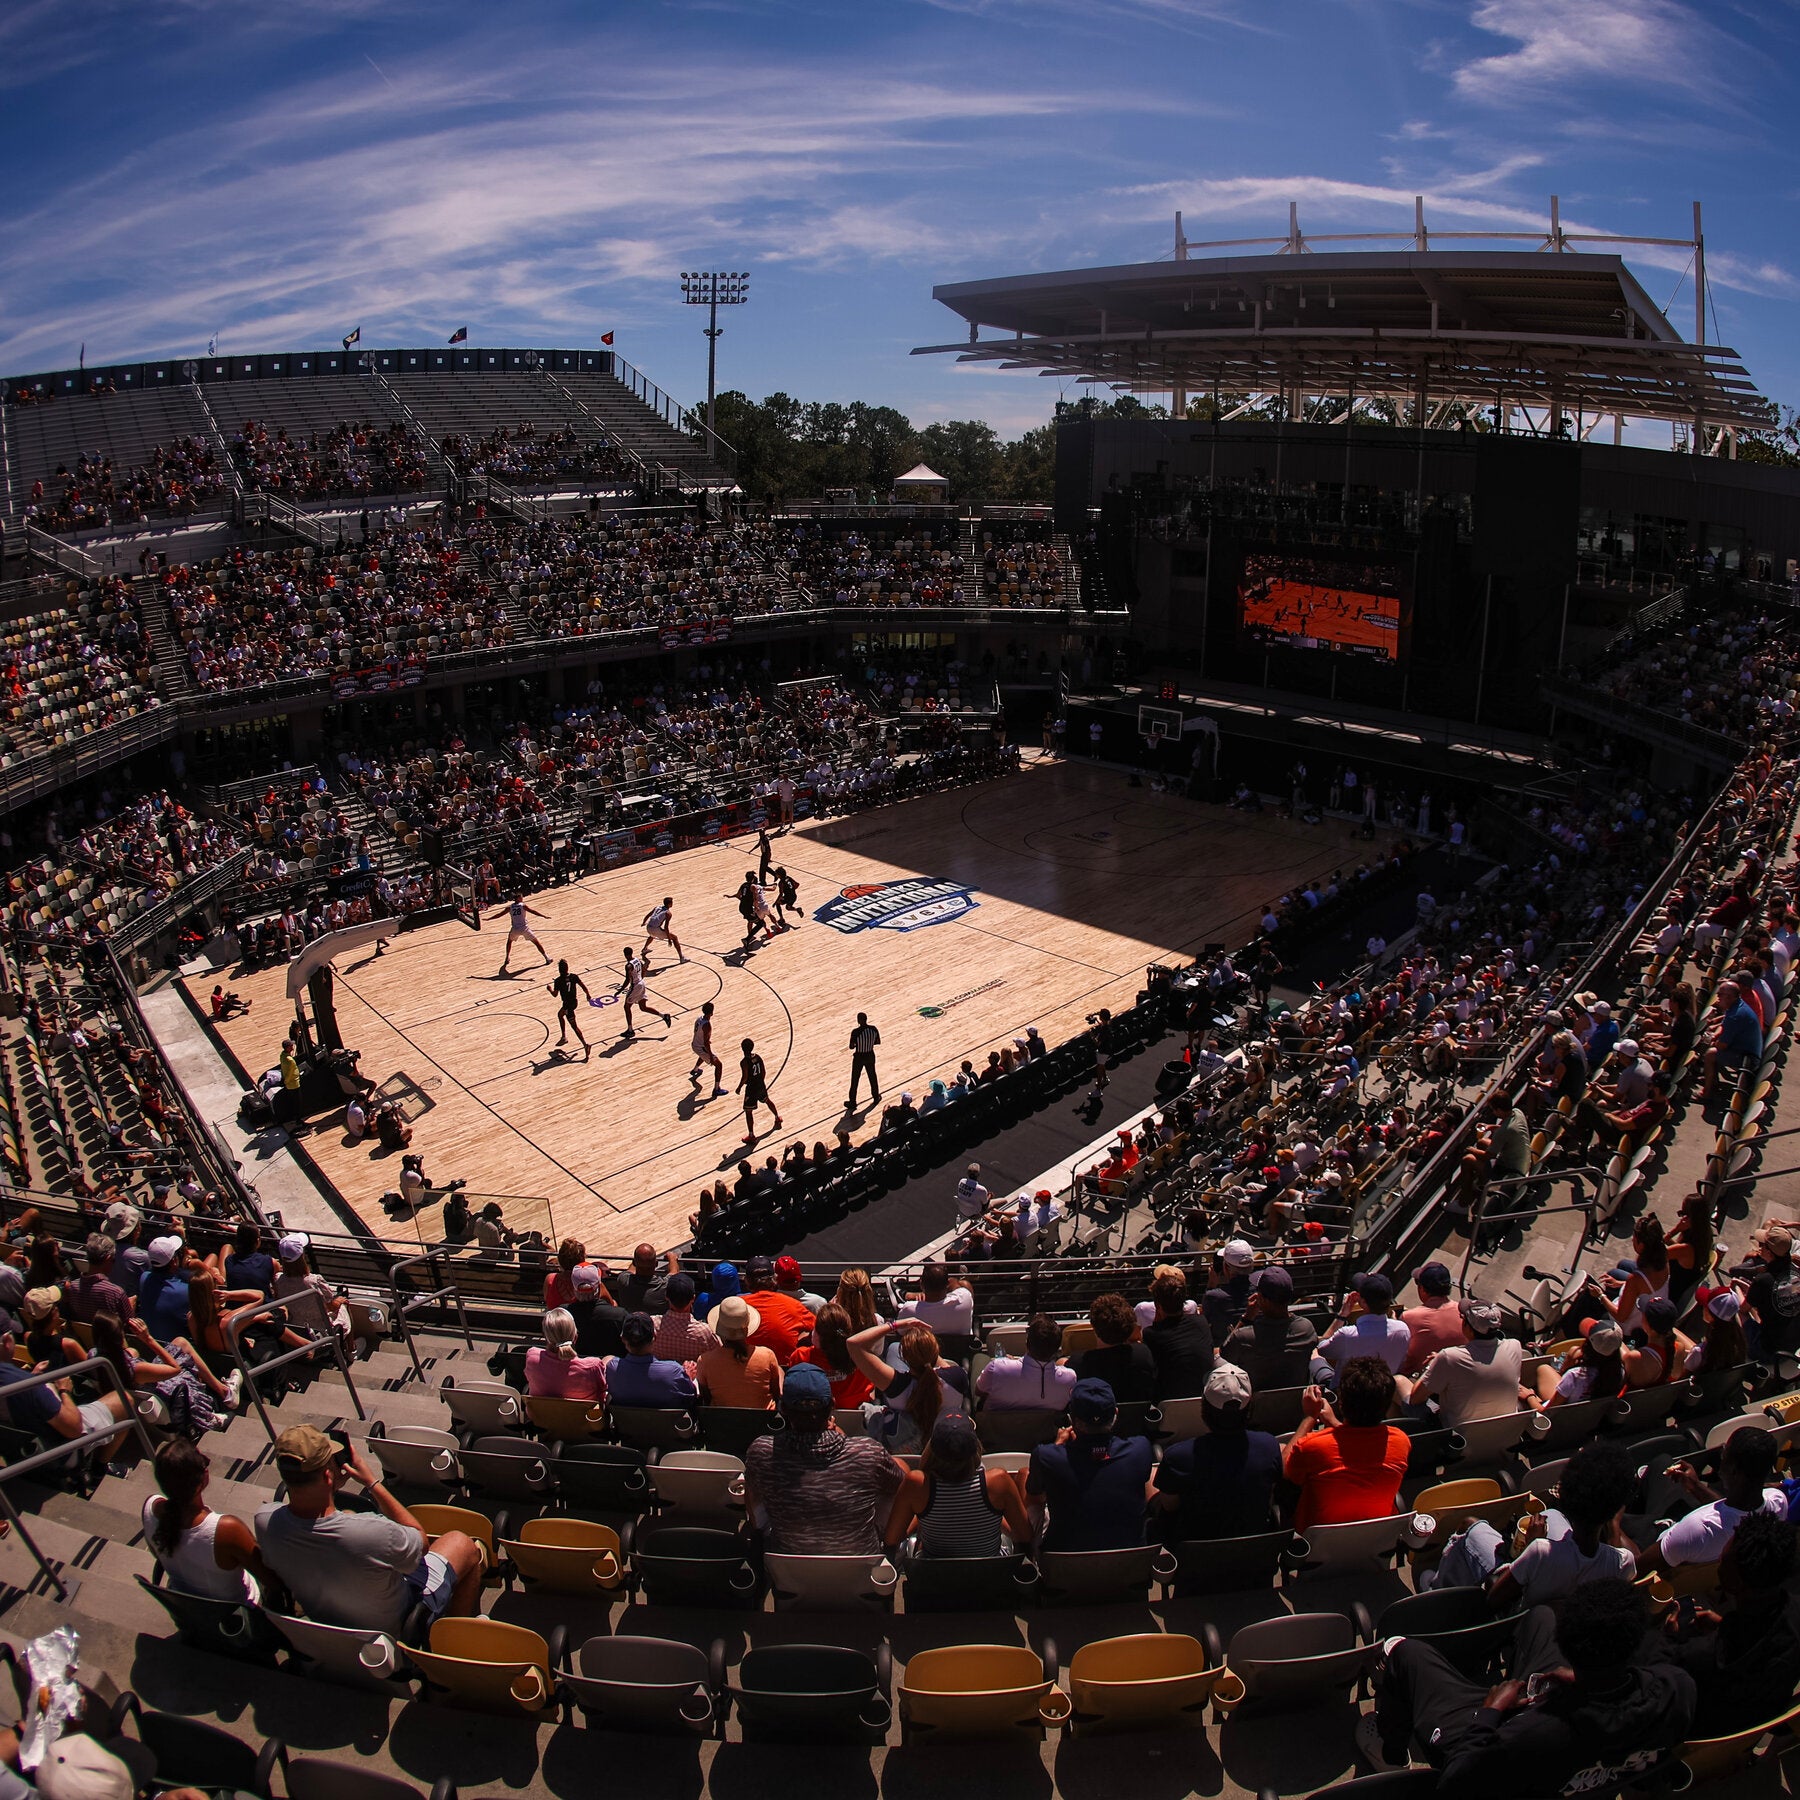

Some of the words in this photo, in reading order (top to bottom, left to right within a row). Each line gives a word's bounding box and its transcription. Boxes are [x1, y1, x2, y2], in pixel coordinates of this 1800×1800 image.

[826, 882, 968, 931] INVITATIONAL
[512, 908, 522, 916] 28
[565, 981, 571, 992] 7
[1201, 1056, 1215, 1064] EVENT
[752, 1063, 761, 1076] 21
[960, 1182, 975, 1192] EVENT
[958, 1188, 972, 1198] STAFF
[1780, 1396, 1800, 1406] STEP
